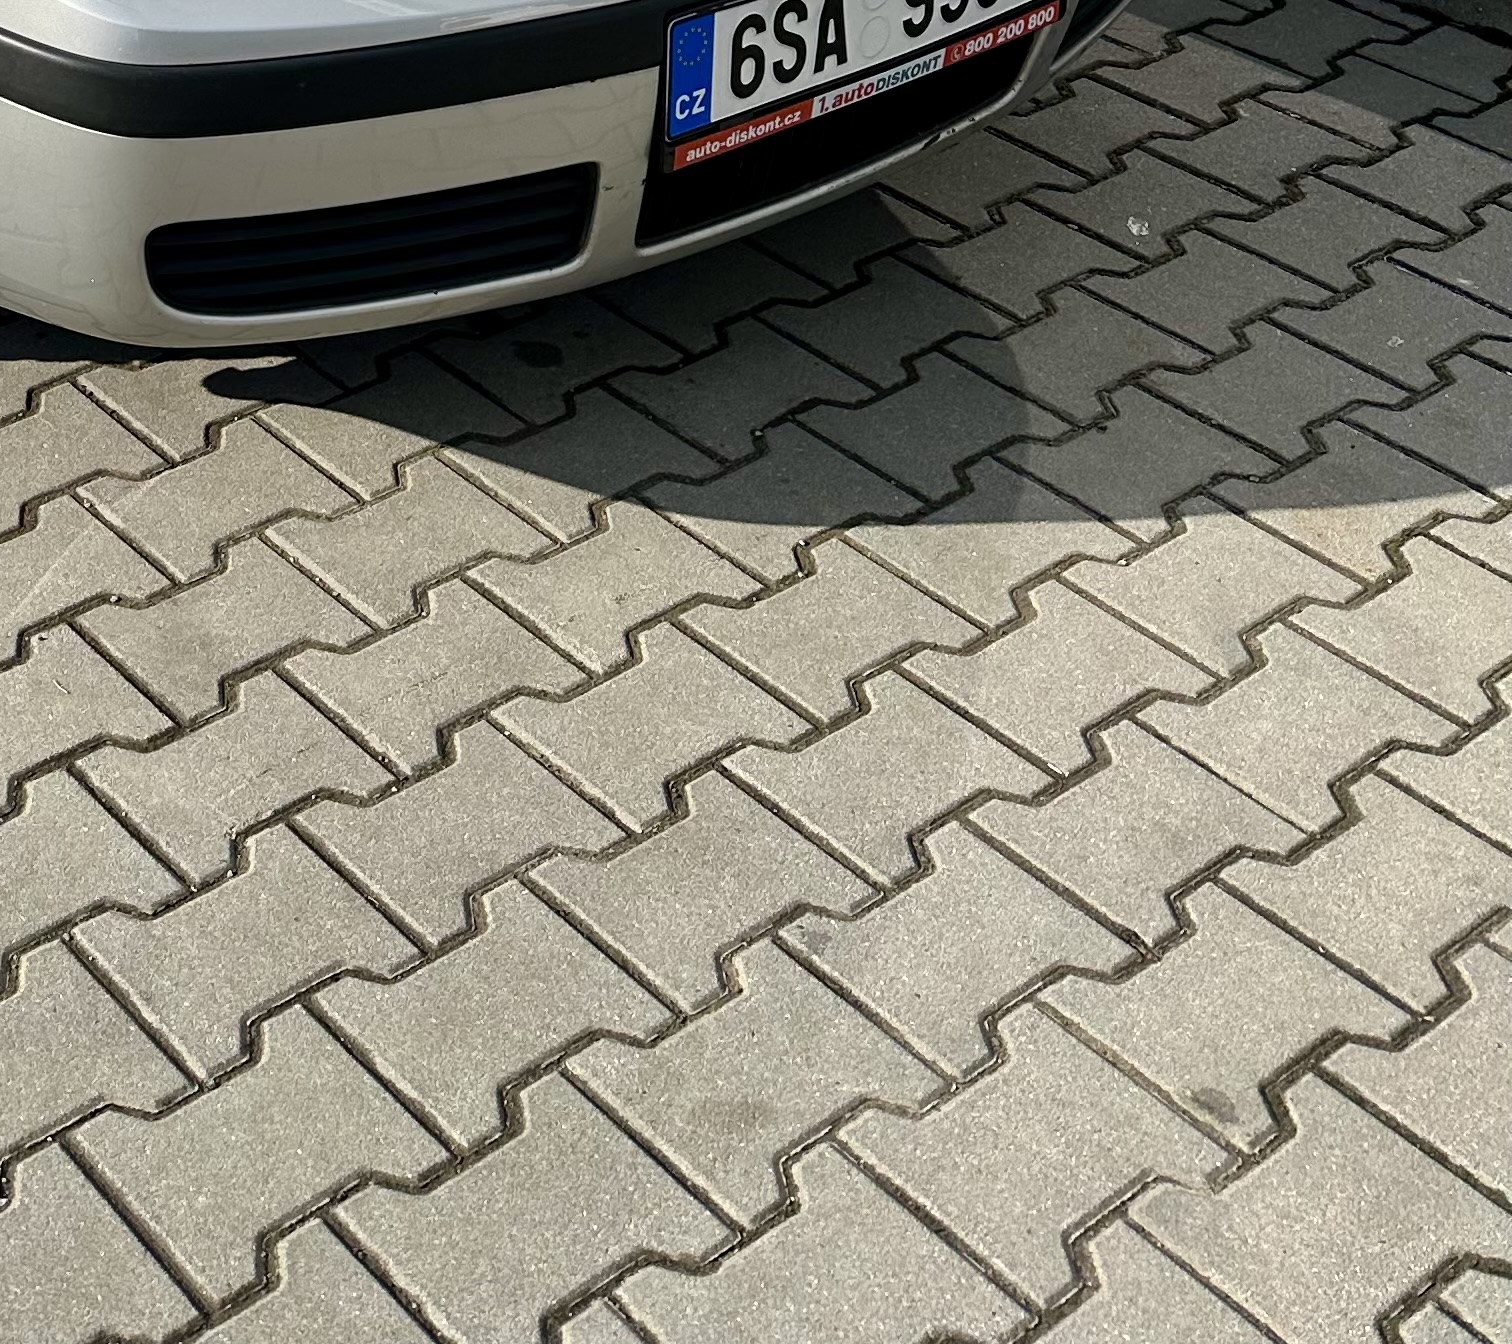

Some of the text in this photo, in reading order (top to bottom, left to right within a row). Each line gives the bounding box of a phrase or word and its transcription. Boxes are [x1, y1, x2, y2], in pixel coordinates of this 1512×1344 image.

[675, 87, 707, 120] CZ
[686, 110, 802, 162] auto-diskont.cz
[964, 32, 994, 57] 800
[997, 20, 1025, 44] 200
[1027, 5, 1055, 31] 800
